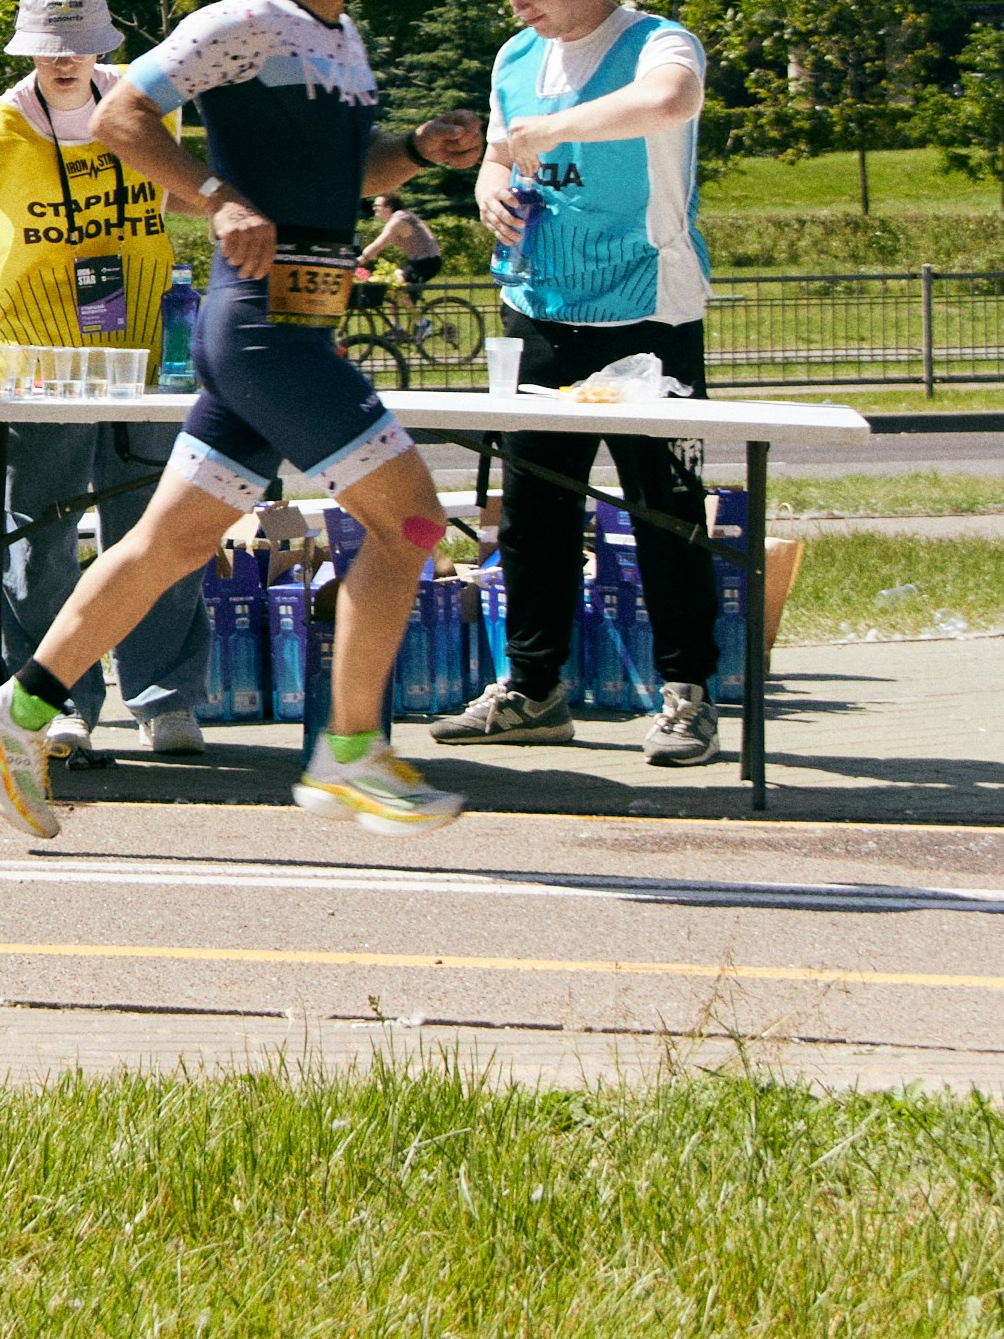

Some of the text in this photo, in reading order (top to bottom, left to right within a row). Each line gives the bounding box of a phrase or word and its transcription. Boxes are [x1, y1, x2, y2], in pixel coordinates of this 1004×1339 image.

[66, 152, 117, 174] IRON STA
[533, 163, 584, 191] ДА
